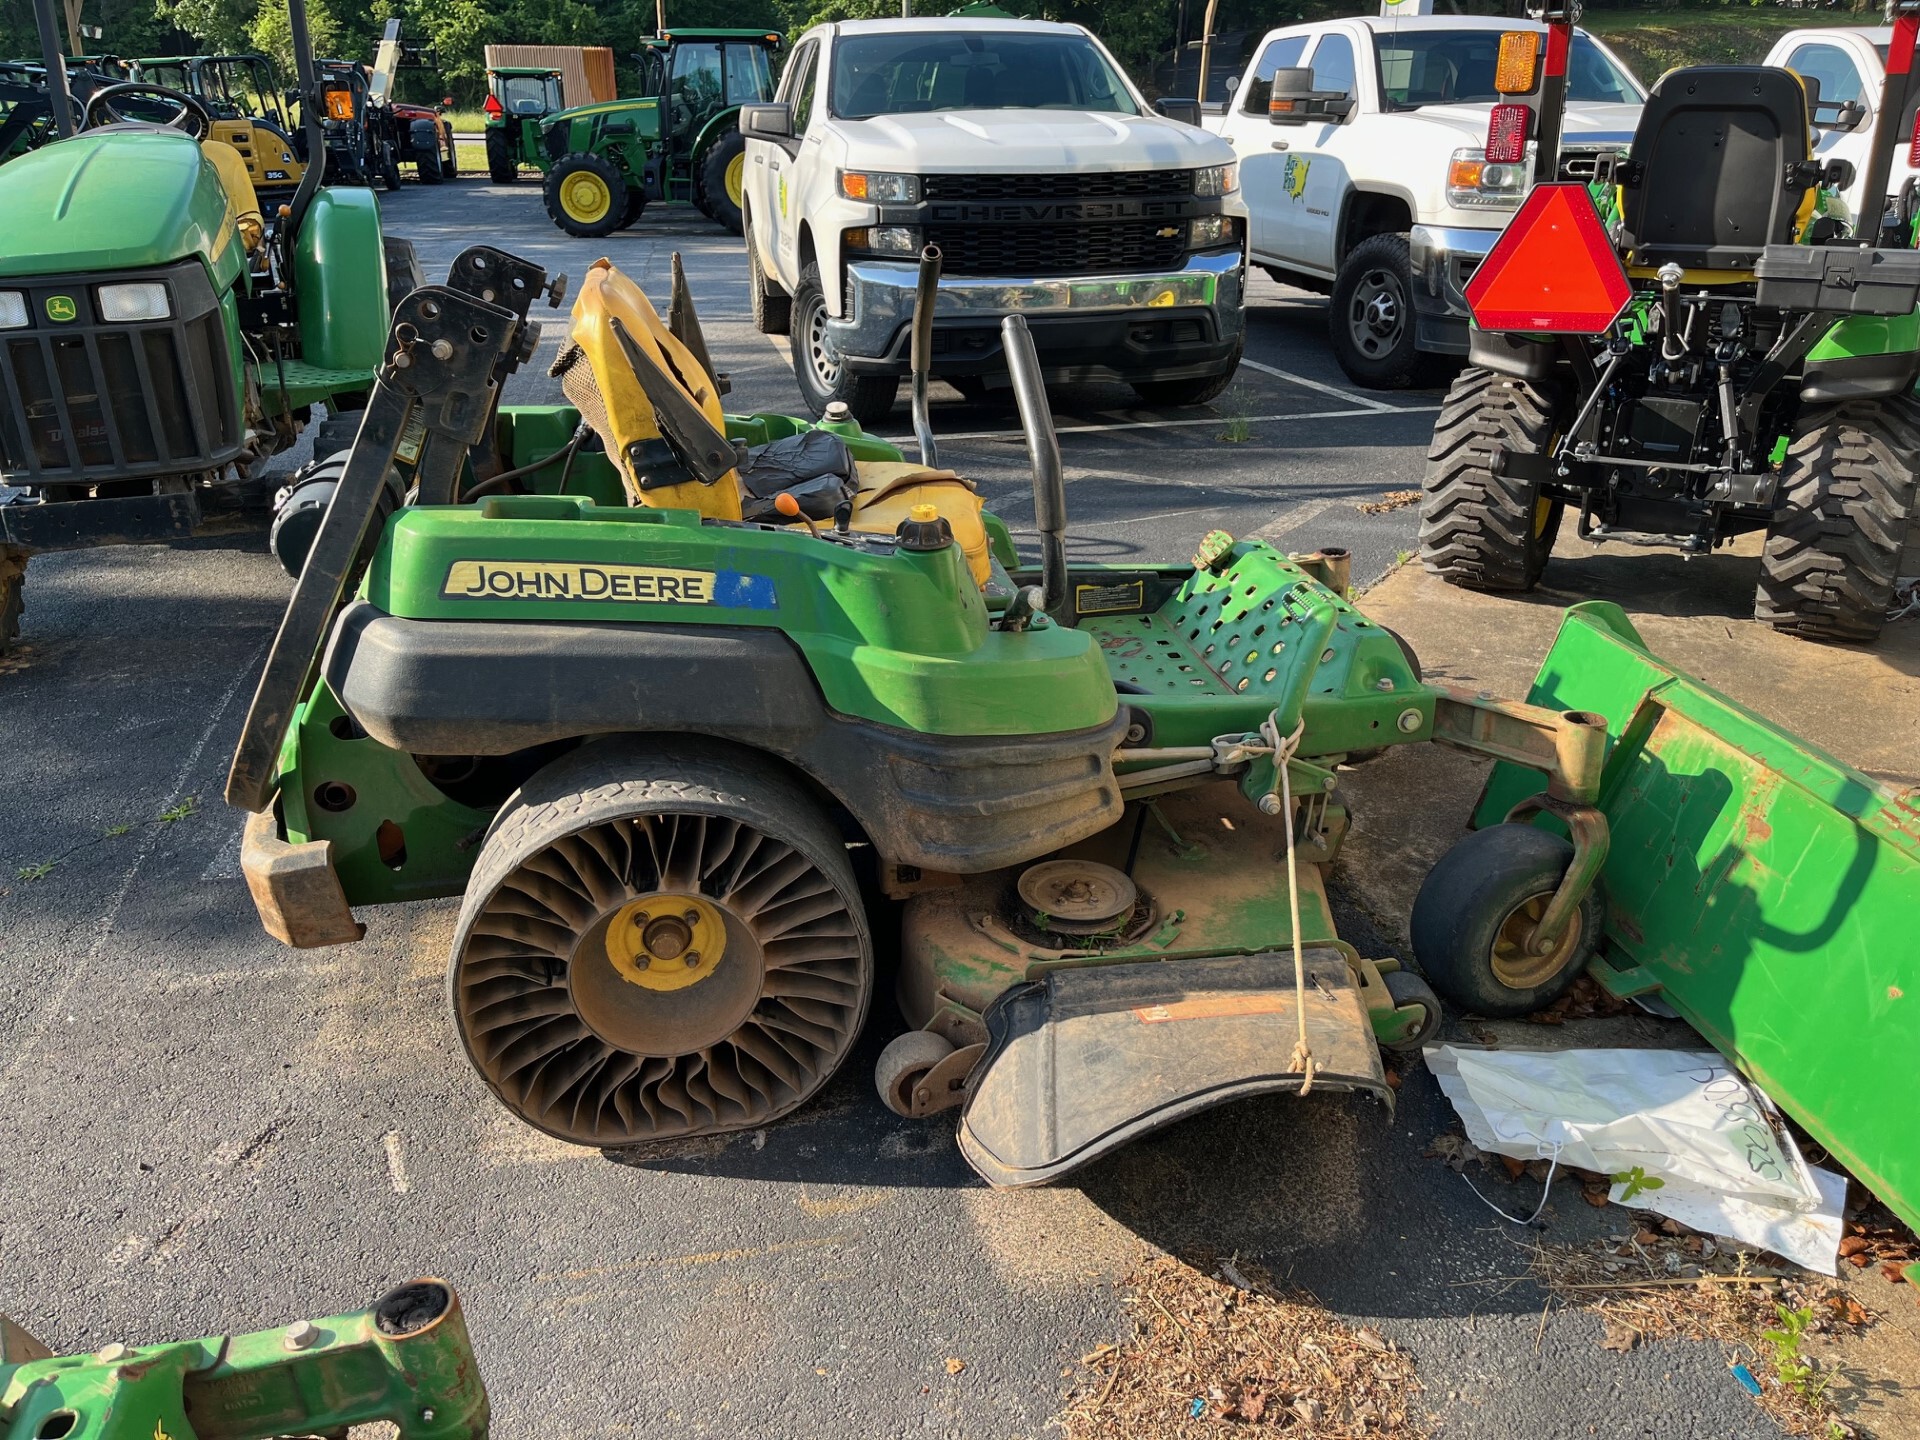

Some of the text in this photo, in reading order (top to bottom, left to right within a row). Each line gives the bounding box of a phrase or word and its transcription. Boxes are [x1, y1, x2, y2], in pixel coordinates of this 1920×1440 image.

[931, 200, 1190, 221] CHEVROLET
[466, 565, 705, 600] JOHN DEERE
